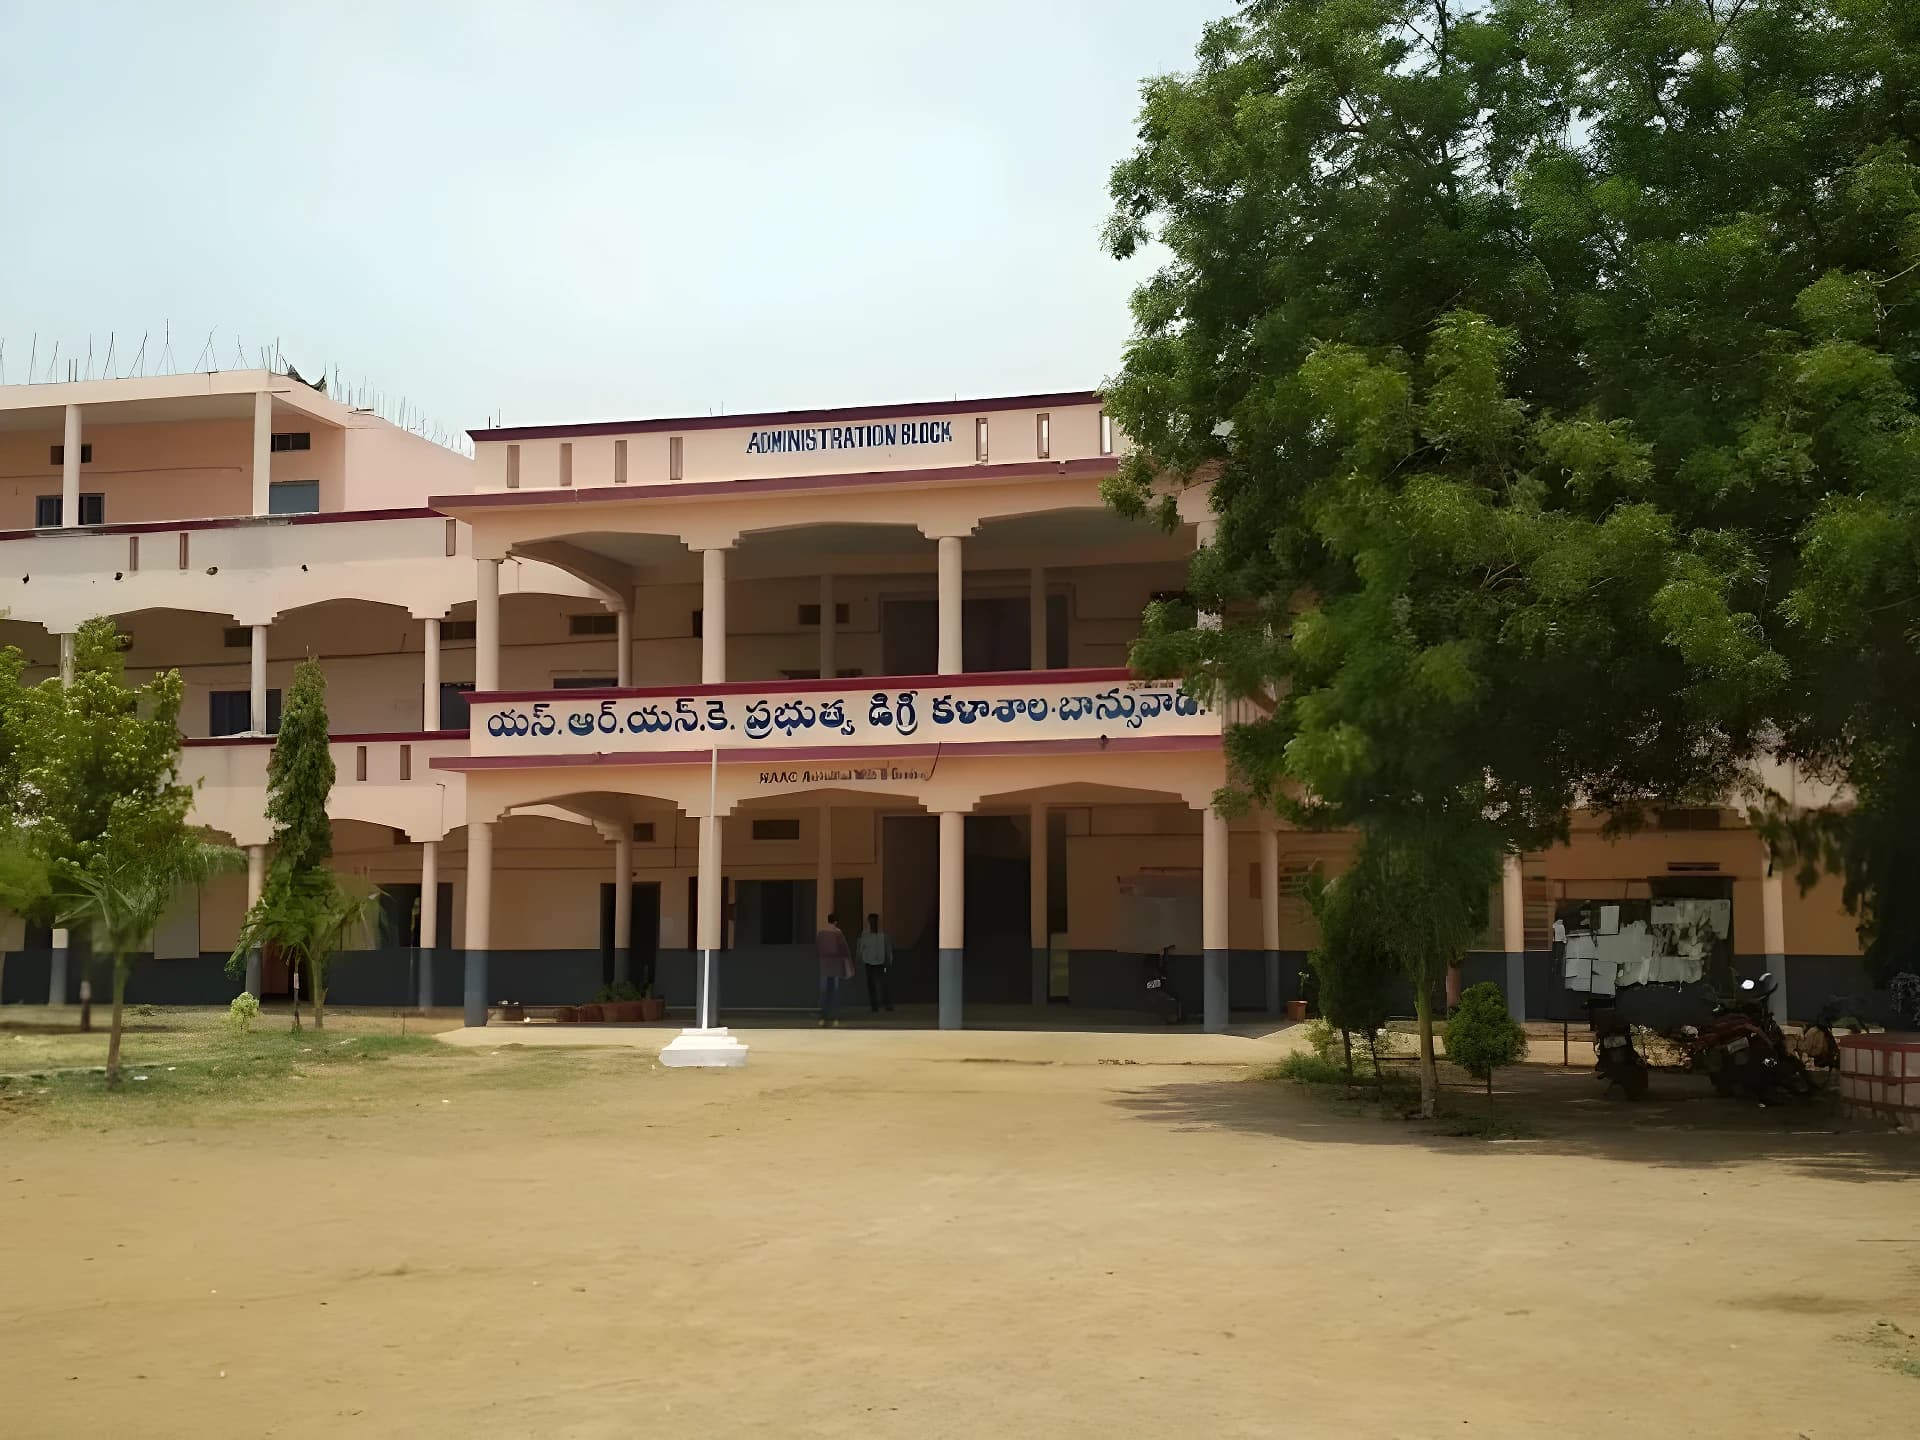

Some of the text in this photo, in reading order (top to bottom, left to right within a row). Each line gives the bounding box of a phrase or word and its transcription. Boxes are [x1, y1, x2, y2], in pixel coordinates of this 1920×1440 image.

[746, 421, 953, 454] ADMINISTRATION BLOCK
[744, 699, 856, 740] ప్రభుత్వ
[868, 690, 919, 736] డిగ్రీ
